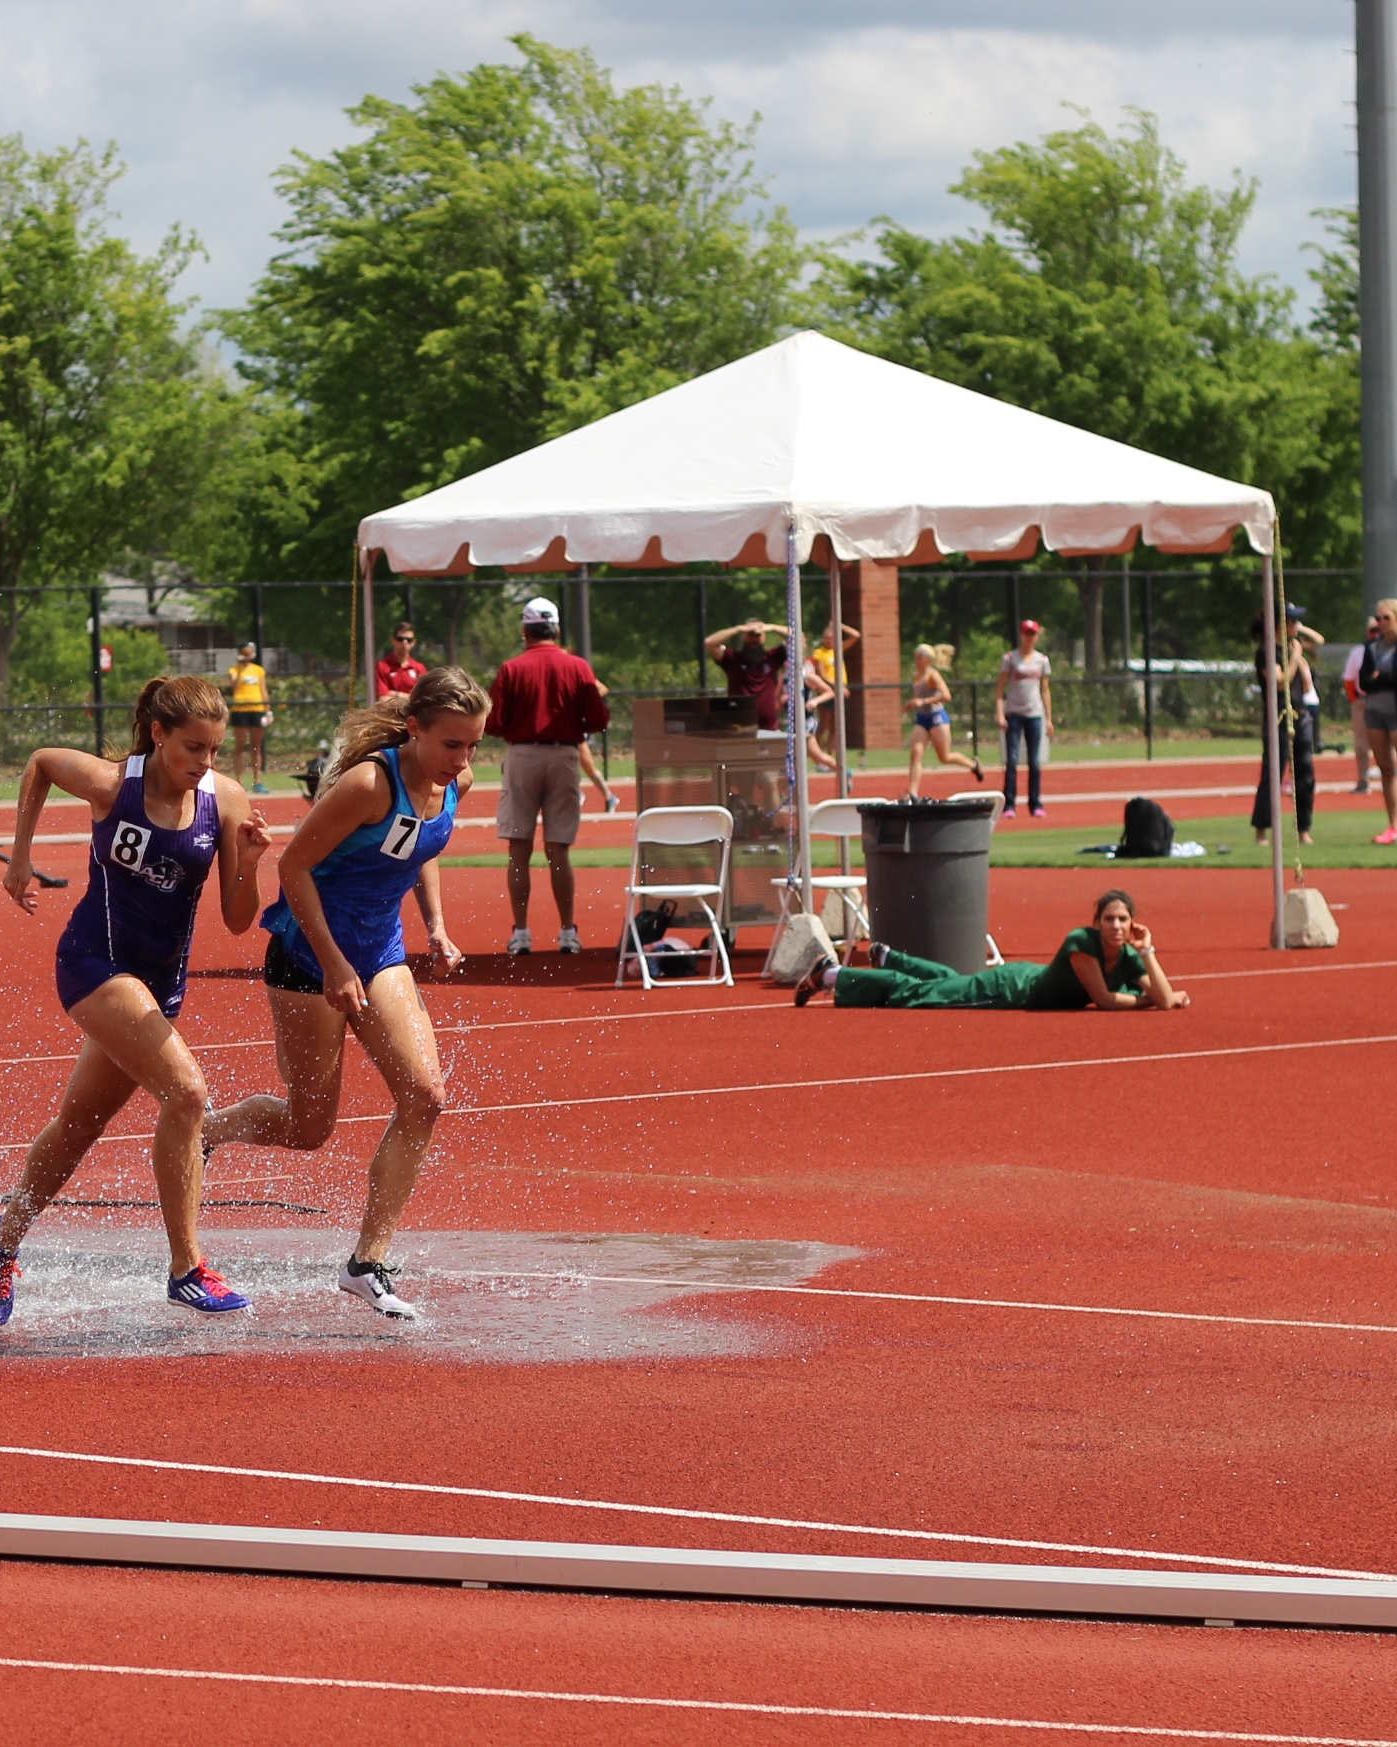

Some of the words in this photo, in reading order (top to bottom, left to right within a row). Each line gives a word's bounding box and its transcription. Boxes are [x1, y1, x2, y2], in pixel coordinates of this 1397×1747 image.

[115, 827, 143, 865] 8
[391, 817, 417, 855] 7
[139, 866, 176, 889] ACU
